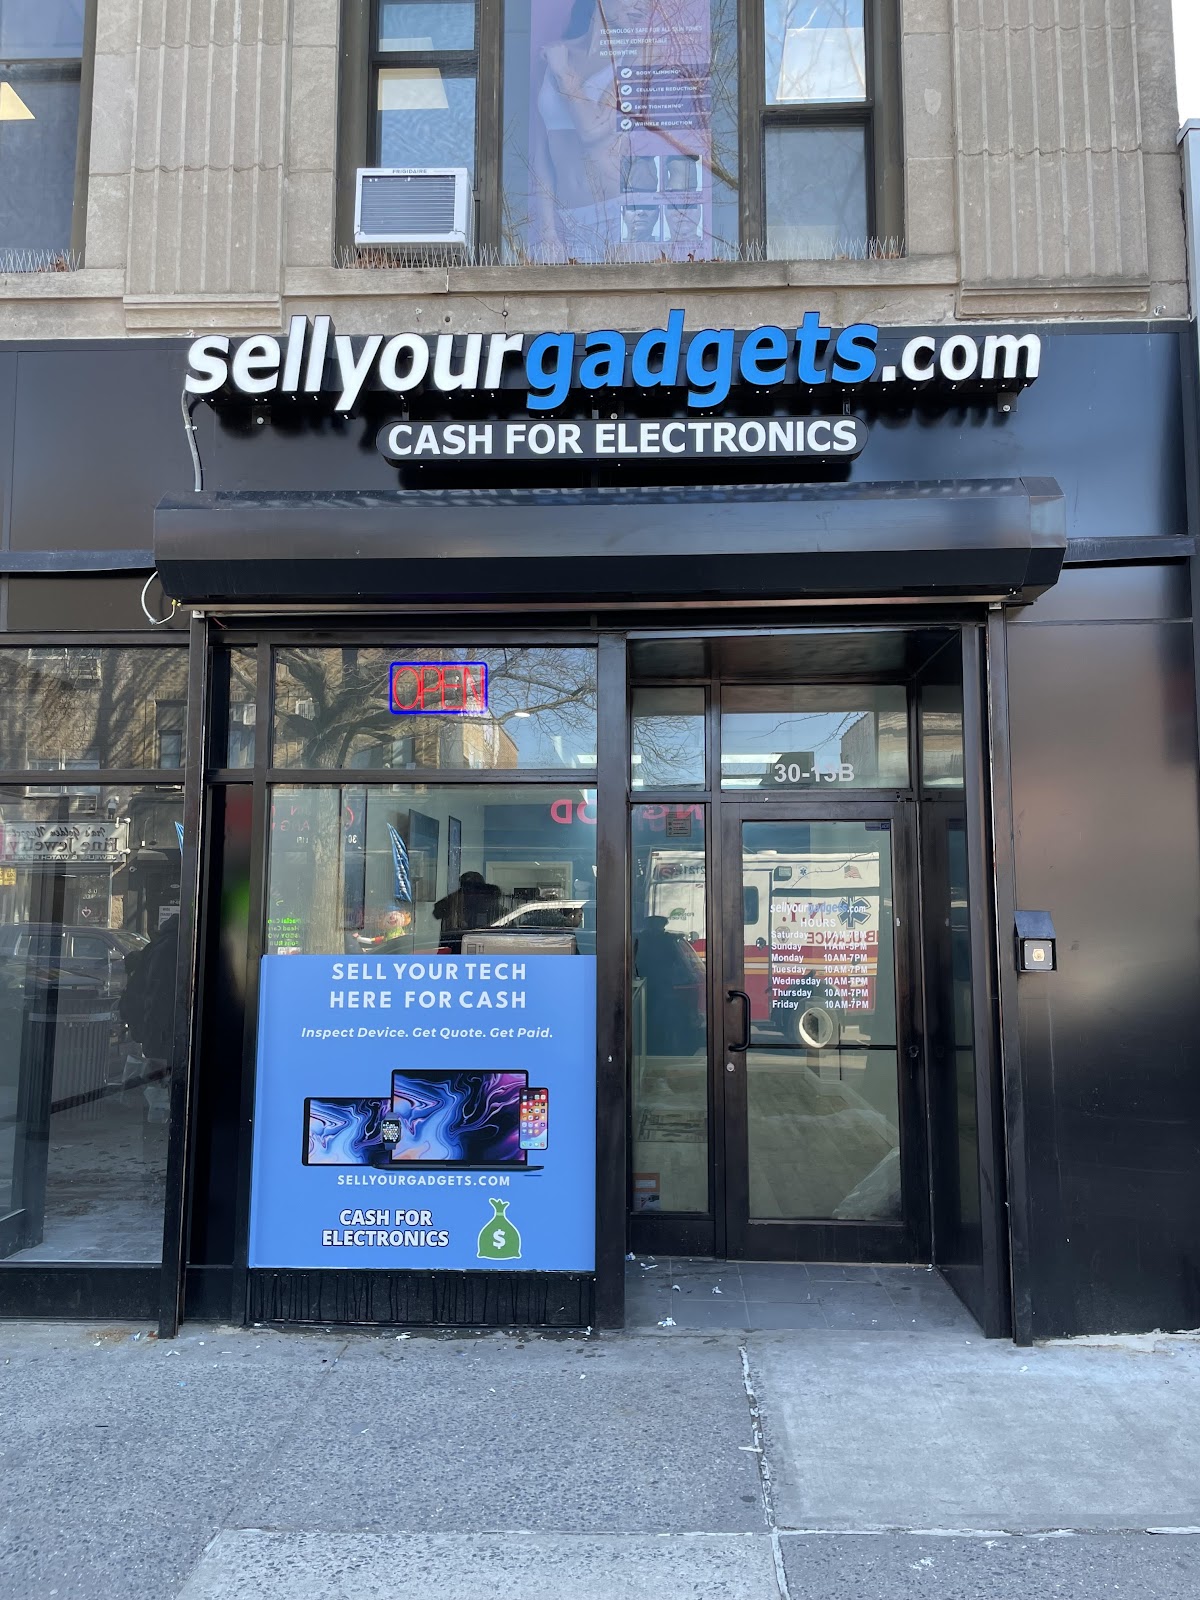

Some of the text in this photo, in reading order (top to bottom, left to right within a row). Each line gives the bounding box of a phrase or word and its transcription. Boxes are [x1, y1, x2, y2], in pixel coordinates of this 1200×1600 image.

[185, 309, 1042, 412] sellyourgadgets.com
[388, 420, 857, 456] CASH FOR ELECTRONICS
[393, 666, 485, 711] OPEN
[770, 901, 866, 914] sellyourgadgets.com
[800, 918, 837, 928] HOURS
[770, 930, 809, 941] Saturday
[771, 942, 802, 952] Sunday
[771, 953, 868, 963] Monday 10AM-7PM
[331, 962, 527, 980] SELL YOUR TECH
[772, 965, 868, 975] Tuesday 10AM-7PM
[772, 977, 869, 987] Wednesday 10AM-7PM
[329, 990, 527, 1009] HERE FOR CASH
[772, 988, 869, 999] Thursday 10AM-7PM
[772, 1000, 869, 1010] Friday 10AM-7PM
[301, 1027, 553, 1041] Inspect Device. Get Quote. Get Paid.
[337, 1174, 511, 1187] SELLYOURGADGETS.COM
[339, 1208, 433, 1226] CASH FOR
[322, 1230, 449, 1247] ELECTRONICS
